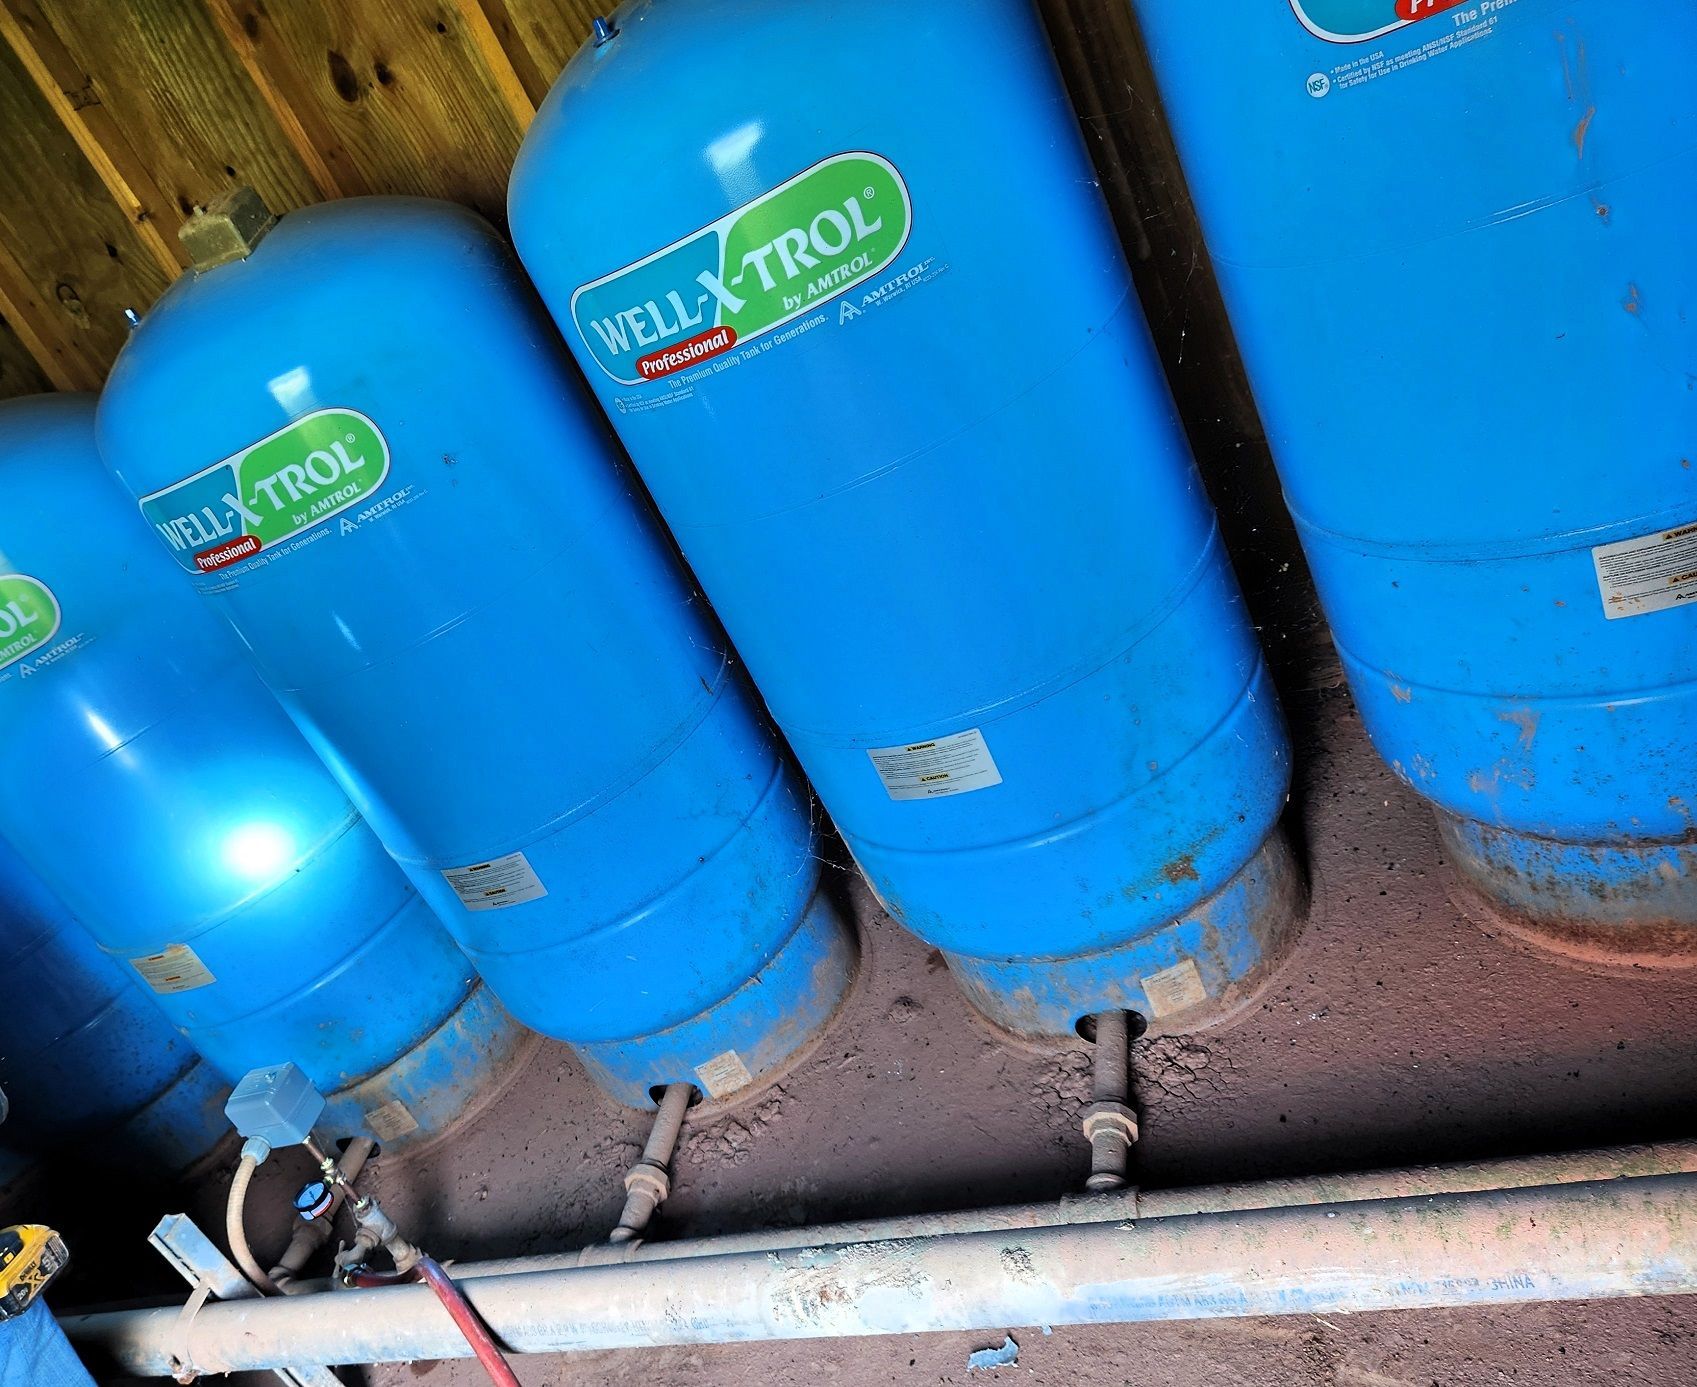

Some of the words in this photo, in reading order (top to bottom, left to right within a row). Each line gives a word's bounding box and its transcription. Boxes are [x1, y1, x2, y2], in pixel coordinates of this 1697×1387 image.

[1452, 9, 1478, 26] The
[1371, 60, 1384, 71] NSF
[1456, 21, 1488, 39] Standard
[1488, 15, 1498, 26] 61
[1334, 64, 1351, 74] Made
[1359, 57, 1369, 65] the
[1370, 51, 1384, 61] USA
[1377, 67, 1391, 76] Use
[1399, 54, 1427, 69] Drinking
[1427, 45, 1448, 57] Water
[1308, 78, 1325, 93] NSF
[782, 293, 802, 313] by
[806, 252, 873, 301] AMTROL
[861, 262, 929, 308] AMTROL
[912, 276, 923, 286] USA
[641, 329, 730, 376] Professional
[668, 378, 682, 390] The
[681, 367, 713, 386] Premium
[713, 354, 741, 373] Quality
[740, 345, 761, 361] Tank
[760, 340, 774, 352] for
[773, 313, 829, 345] Generations.
[292, 511, 308, 525] by
[310, 481, 362, 516] AMTROL
[357, 489, 411, 523] AMTROL
[197, 537, 257, 570] Professional
[268, 550, 282, 562] Tank
[926, 773, 949, 781] CAUTION
